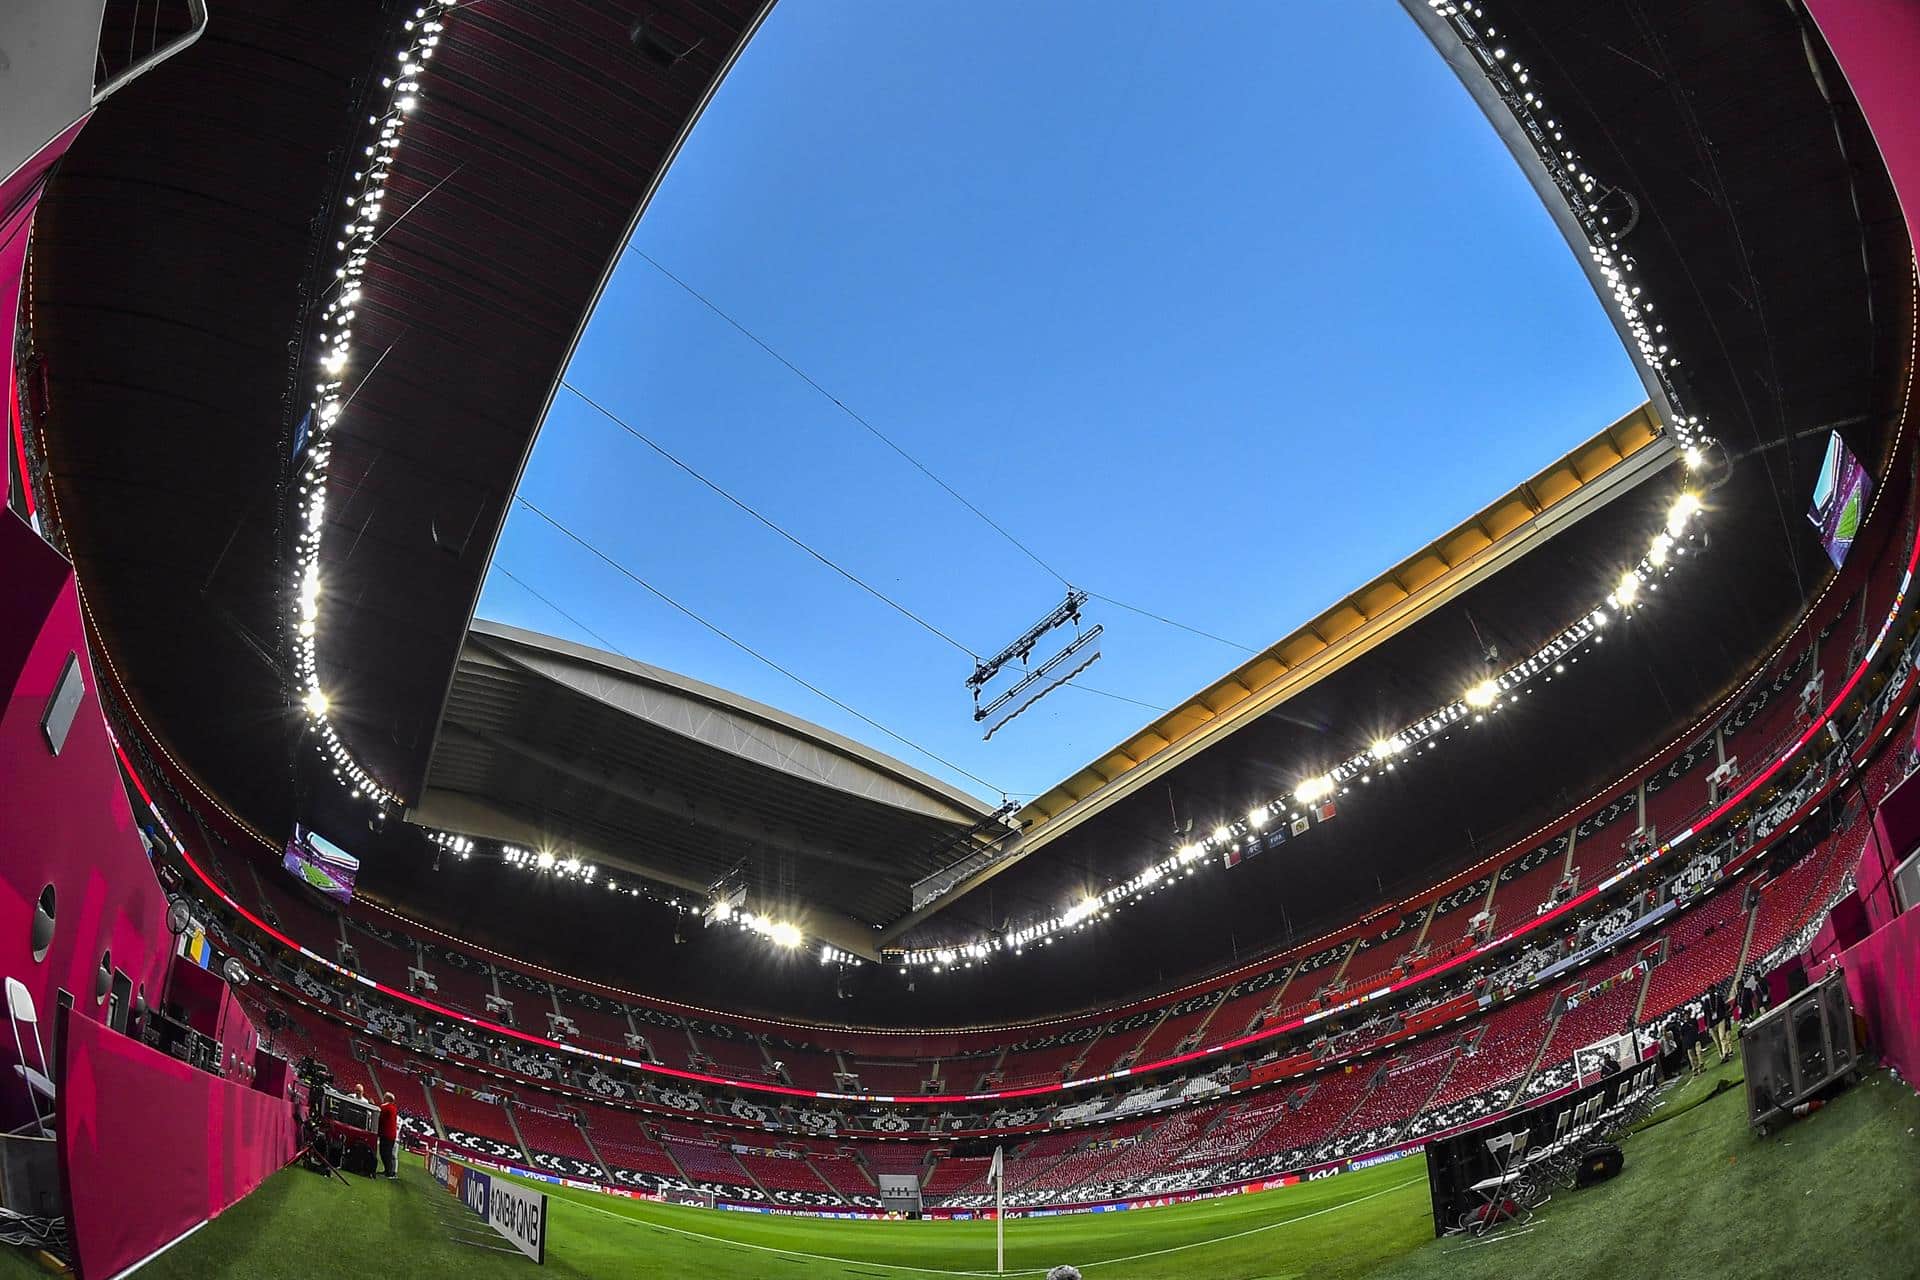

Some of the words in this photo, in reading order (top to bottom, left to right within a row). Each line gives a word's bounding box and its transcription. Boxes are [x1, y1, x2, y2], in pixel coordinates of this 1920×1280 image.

[523, 1171, 548, 1182] vivo
[1309, 1166, 1339, 1181] KIA
[466, 1170, 485, 1215] vivo
[495, 1188, 511, 1228] QNB
[516, 1198, 539, 1247] QNB
[769, 1208, 792, 1216] QATAR
[792, 1210, 820, 1218] AIRWAYS
